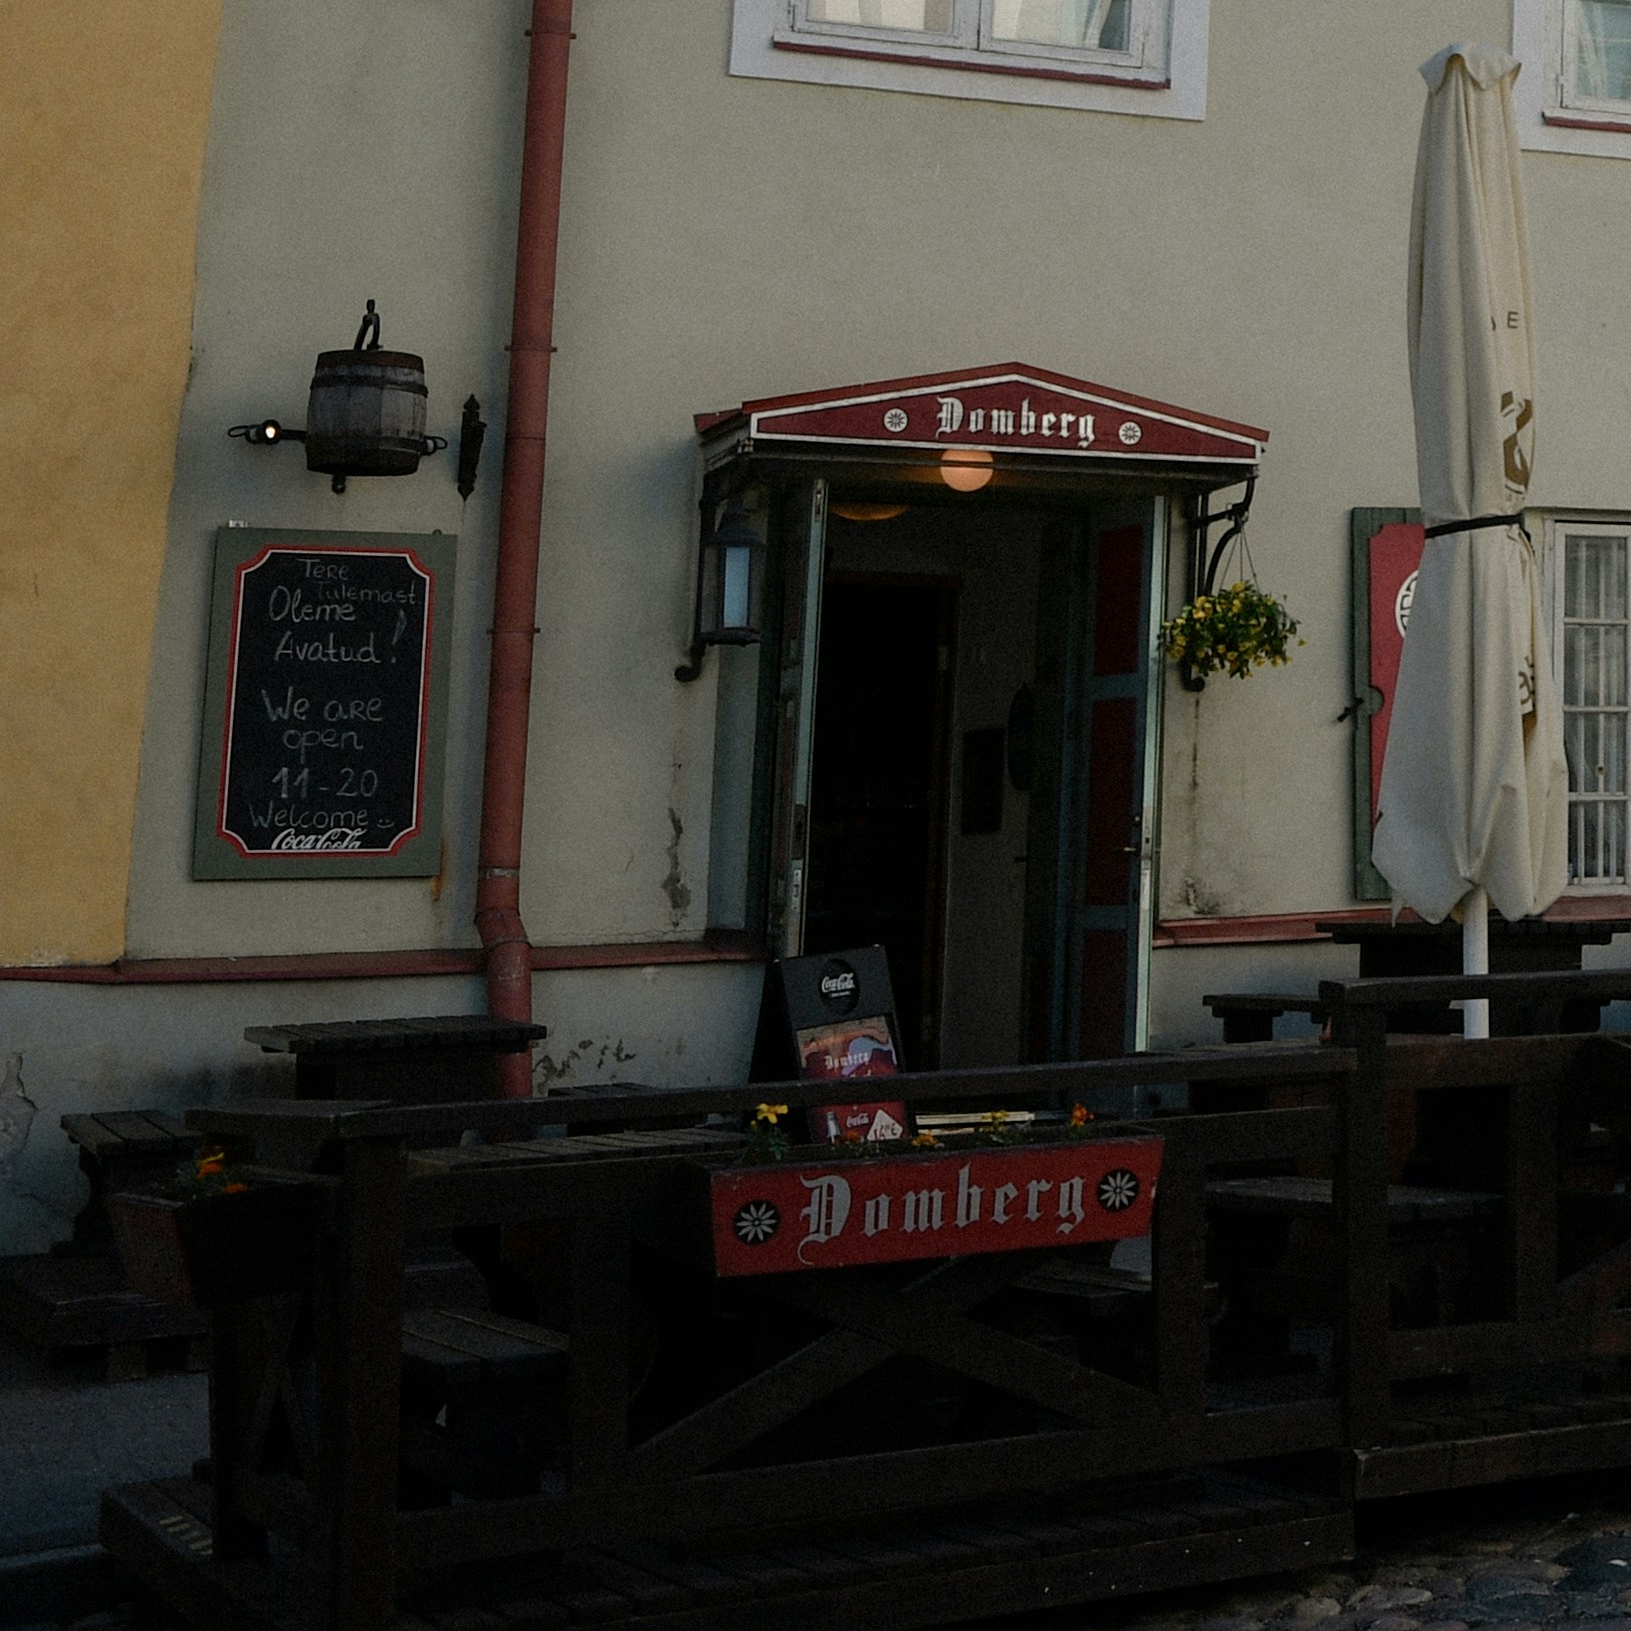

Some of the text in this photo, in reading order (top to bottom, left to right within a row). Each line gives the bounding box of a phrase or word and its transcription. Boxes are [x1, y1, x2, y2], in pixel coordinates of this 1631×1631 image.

[935, 395, 1096, 448] Domberg
[268, 584, 356, 623] Oleme
[261, 686, 310, 722] We
[282, 728, 364, 765] open
[249, 800, 369, 829] Welcome
[797, 1161, 1087, 1266] Domberg
